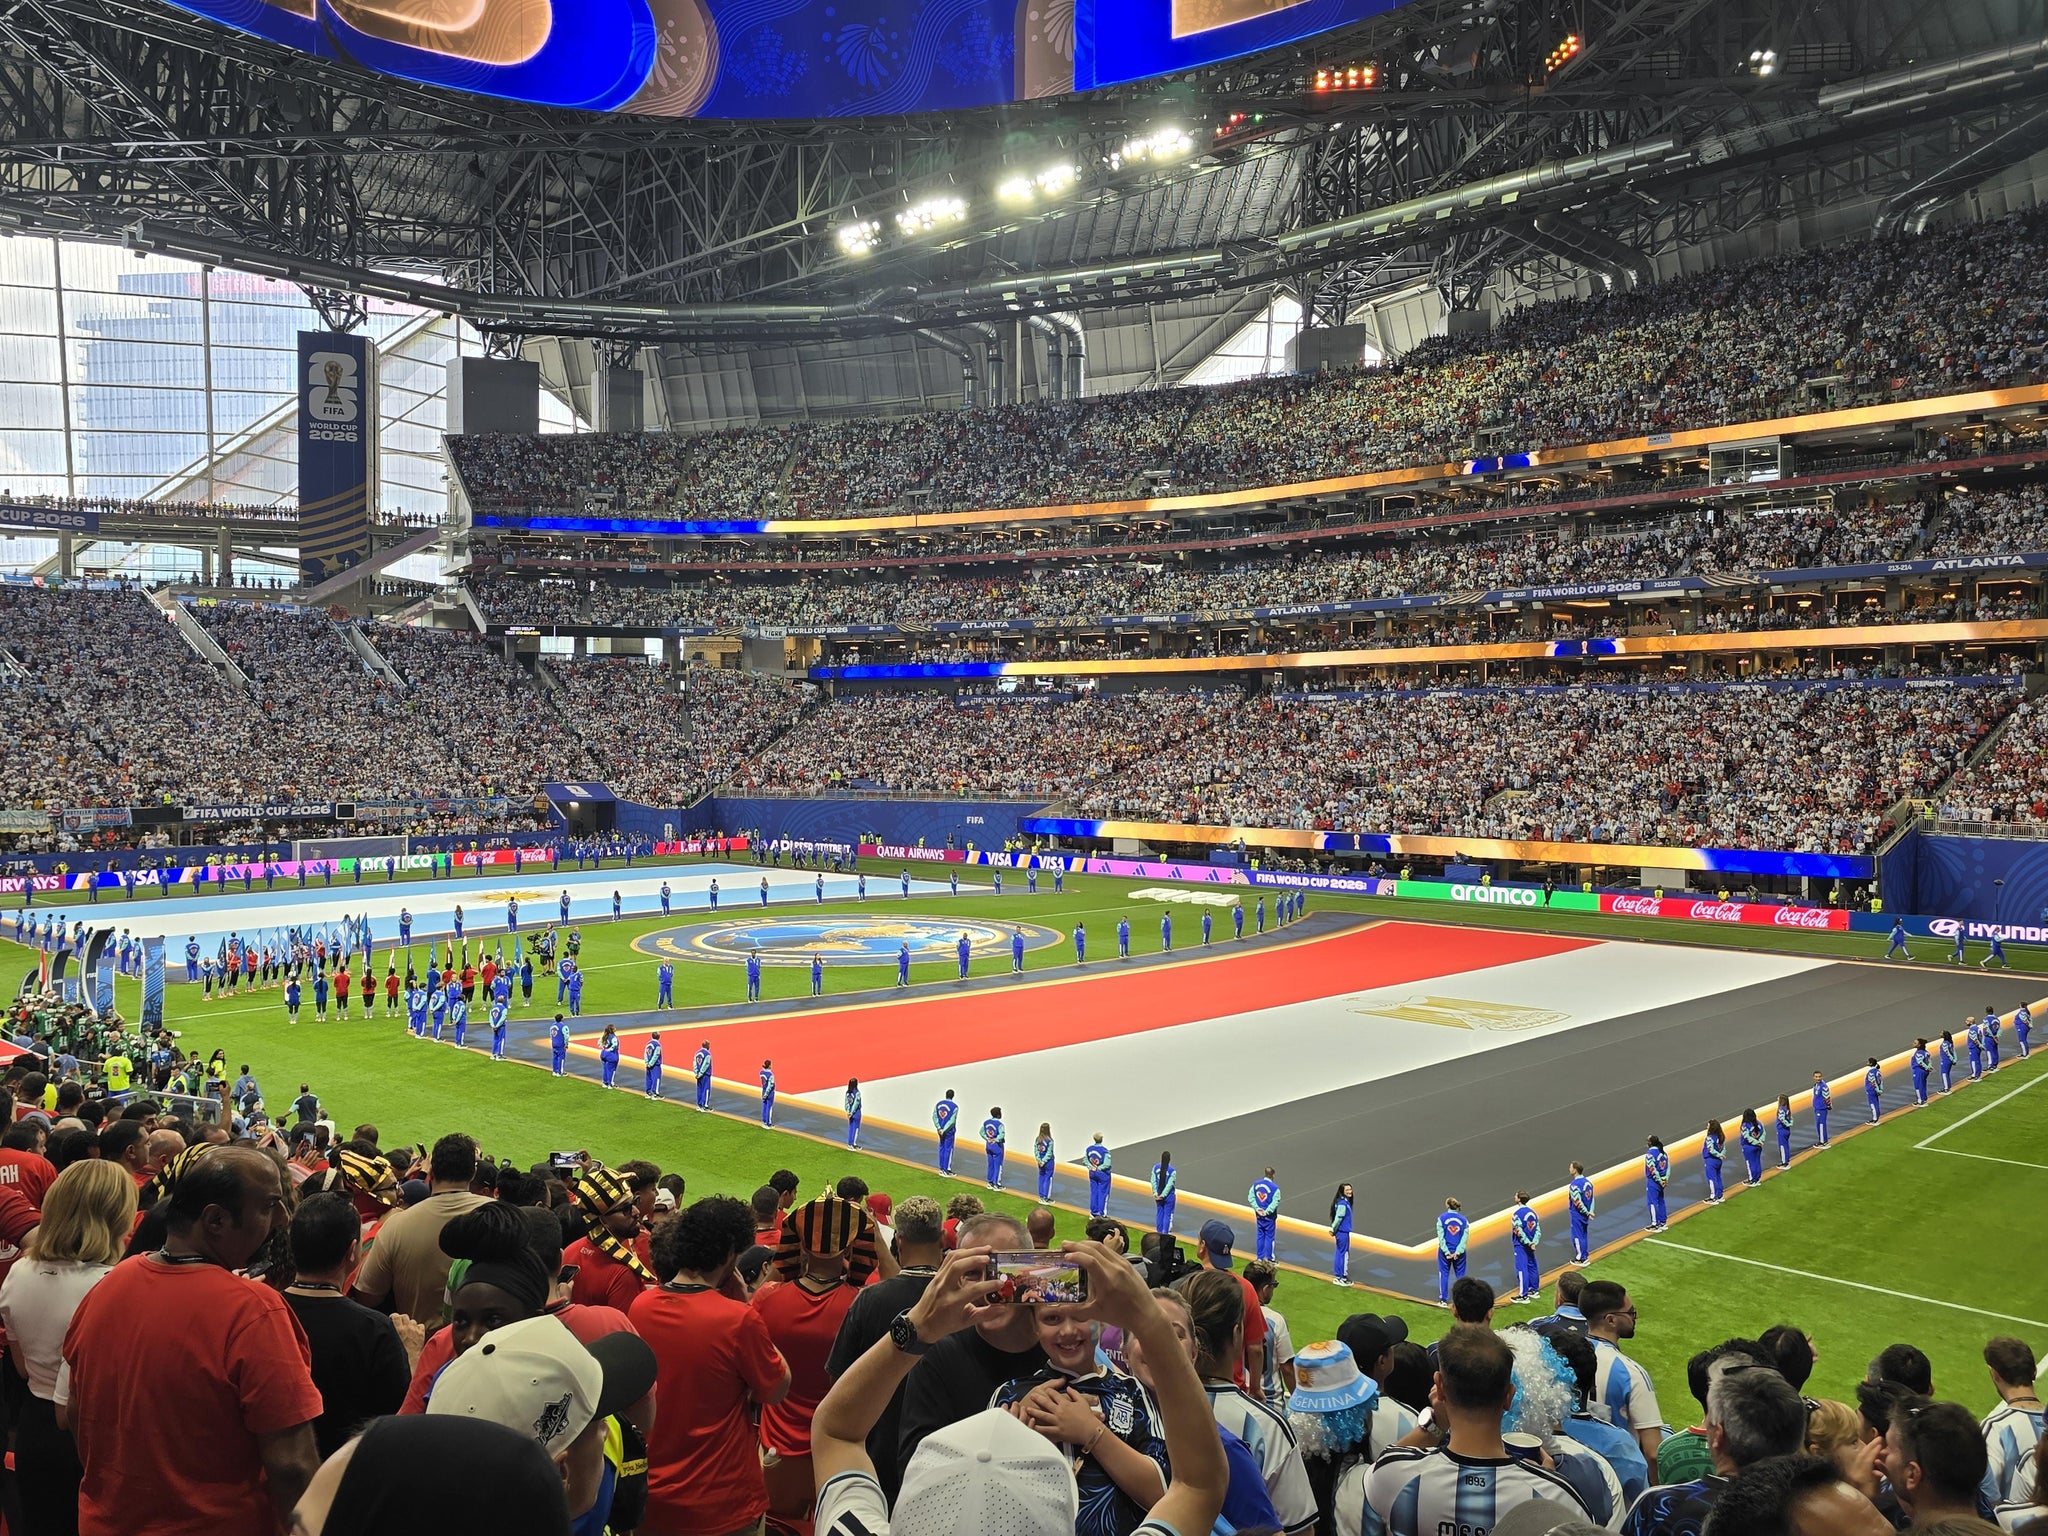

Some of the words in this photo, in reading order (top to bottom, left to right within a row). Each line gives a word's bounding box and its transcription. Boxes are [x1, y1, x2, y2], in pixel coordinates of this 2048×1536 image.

[323, 407, 345, 415] FIFA
[309, 430, 358, 442] 2026
[0, 510, 30, 521] CUP
[33, 512, 86, 526] 2026
[1932, 555, 2025, 570] ATLANTA
[1532, 588, 1552, 598] FIFA
[1553, 585, 1586, 596] WORLD
[1588, 584, 1606, 594] CUP
[1607, 582, 1641, 592] 2026
[1268, 606, 1320, 616] ATLANTA
[222, 808, 265, 818] WORLD
[266, 806, 290, 816] CUP
[290, 805, 330, 815] 2026
[492, 838, 510, 846] FIFA
[876, 846, 905, 858] QATAR
[908, 848, 944, 860] AIRWAYS
[985, 852, 1012, 866] VISA
[1036, 856, 1064, 870] VISA
[1256, 874, 1276, 882] FIFA
[1277, 876, 1309, 886] WORLD
[1310, 878, 1330, 888] CUP
[1451, 884, 1536, 906] aramco
[1612, 896, 1660, 914] Coca-Cola
[1690, 901, 1743, 921] Coca-Cola
[1774, 907, 1832, 928] Coca-Cola
[1294, 1393, 1356, 1408] GENTINA
[1465, 1475, 1486, 1488] 1893
